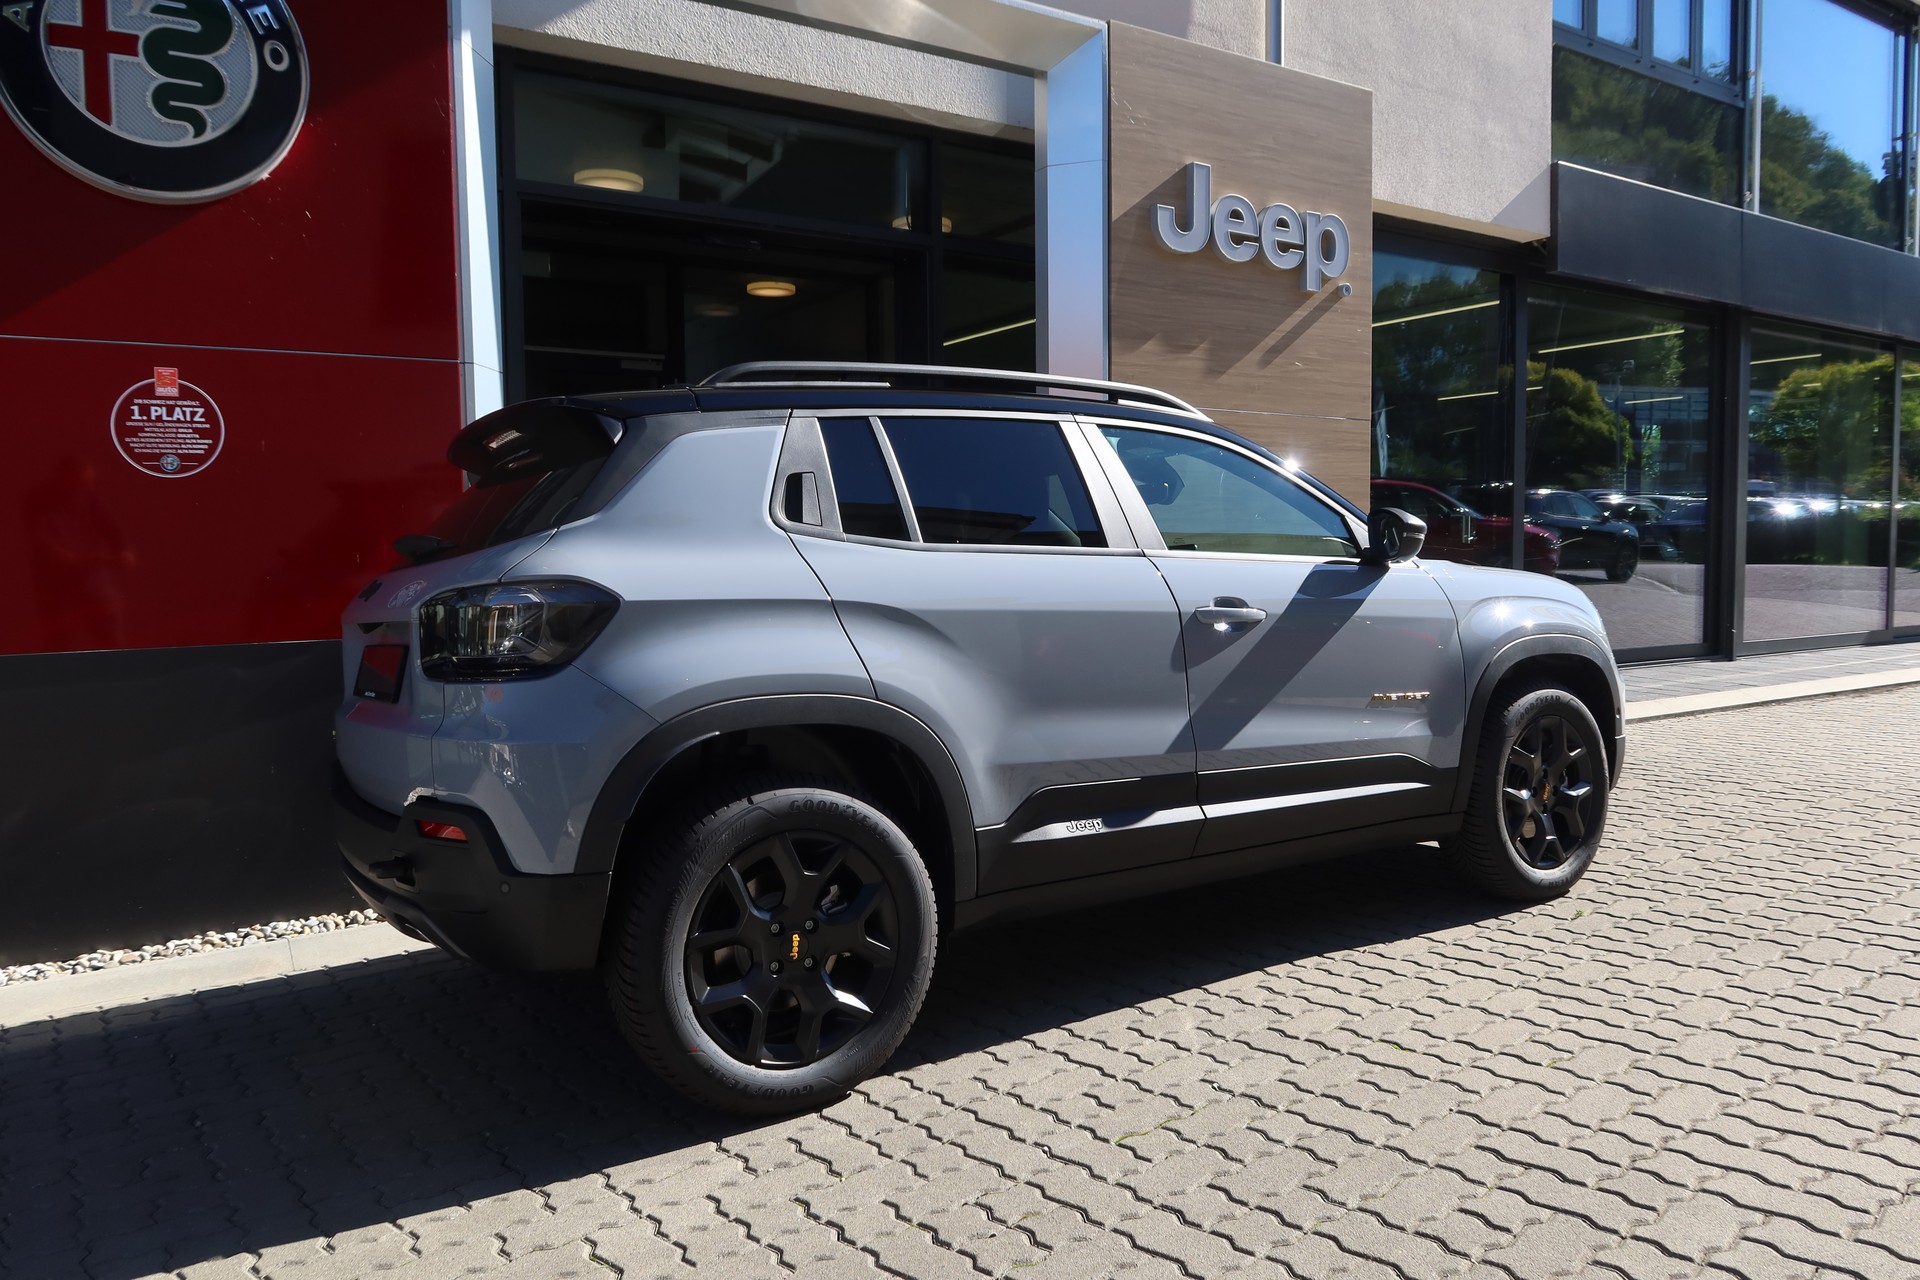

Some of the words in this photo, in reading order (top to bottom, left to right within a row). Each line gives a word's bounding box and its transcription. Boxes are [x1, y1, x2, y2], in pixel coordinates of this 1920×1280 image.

[1152, 161, 1350, 293] Jeep
[130, 405, 148, 420] 1.
[150, 406, 206, 422] PLATZ
[1066, 817, 1104, 833] Jeep
[789, 931, 801, 960] Jeep
